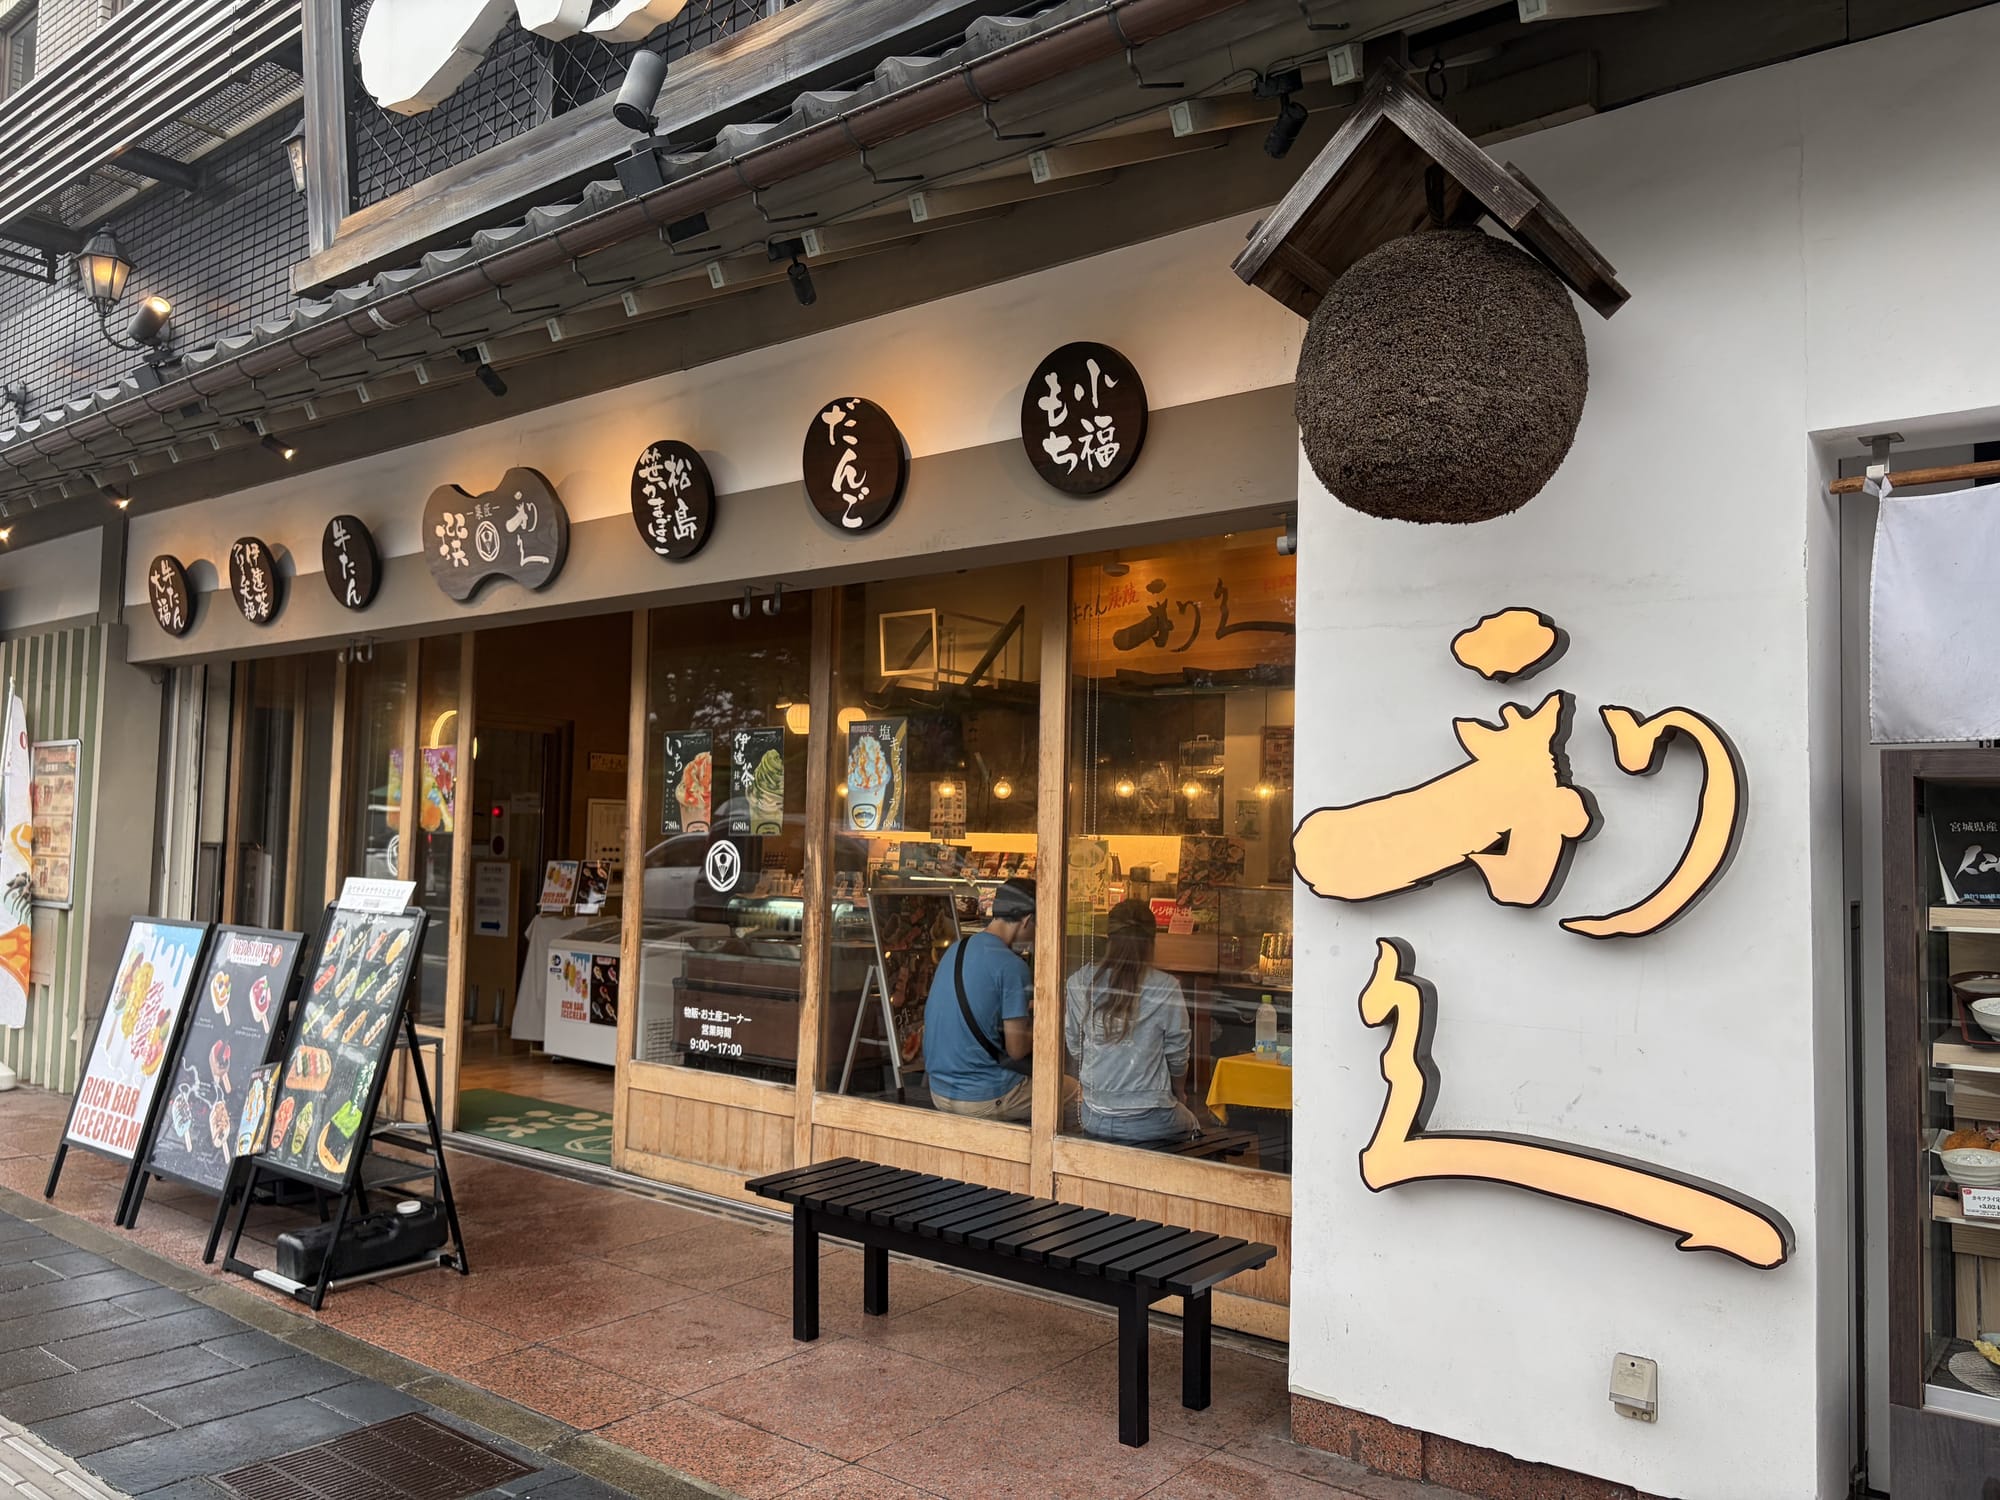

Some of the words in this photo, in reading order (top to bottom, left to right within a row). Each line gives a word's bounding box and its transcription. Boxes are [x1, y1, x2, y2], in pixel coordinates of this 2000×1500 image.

[1037, 371, 1080, 475] もち
[1073, 357, 1121, 473] 小福
[821, 398, 871, 529] だんご
[664, 454, 698, 541] 松島
[161, 559, 185, 630] 牛たん
[332, 519, 362, 608] 牛たん
[665, 735, 683, 784] いちご
[733, 732, 755, 788] 伊達茶
[1949, 821, 1999, 833] 宮城県産
[701, 1024, 732, 1039] 営業時間
[81, 1075, 115, 1110] RICH
[110, 1083, 141, 1118] BAR
[71, 1105, 142, 1152] ICECREAM
